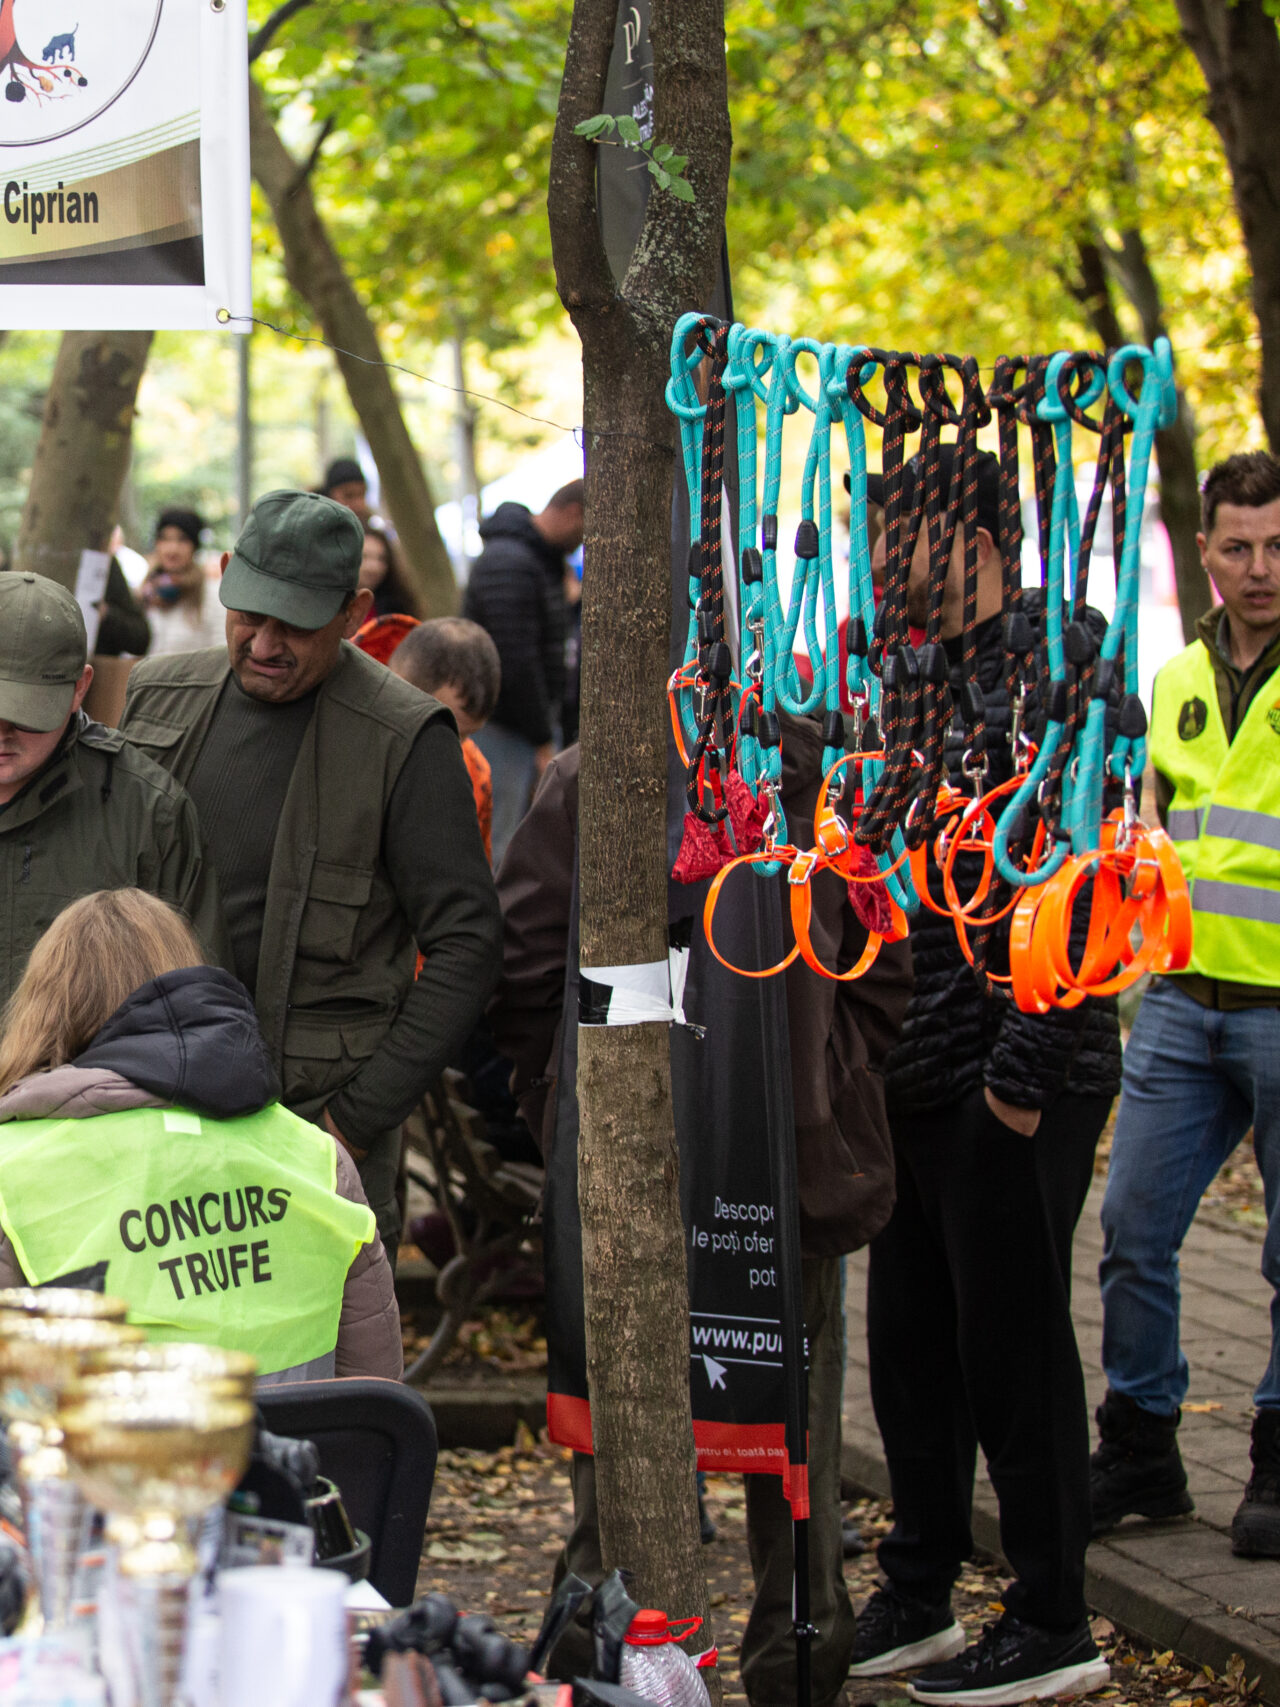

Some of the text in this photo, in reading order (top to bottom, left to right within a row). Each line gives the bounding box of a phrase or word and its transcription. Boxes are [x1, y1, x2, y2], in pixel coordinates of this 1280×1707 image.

[3, 181, 99, 235] Ciprian
[119, 1185, 291, 1253] CONCURS
[158, 1239, 272, 1300] TRUFE
